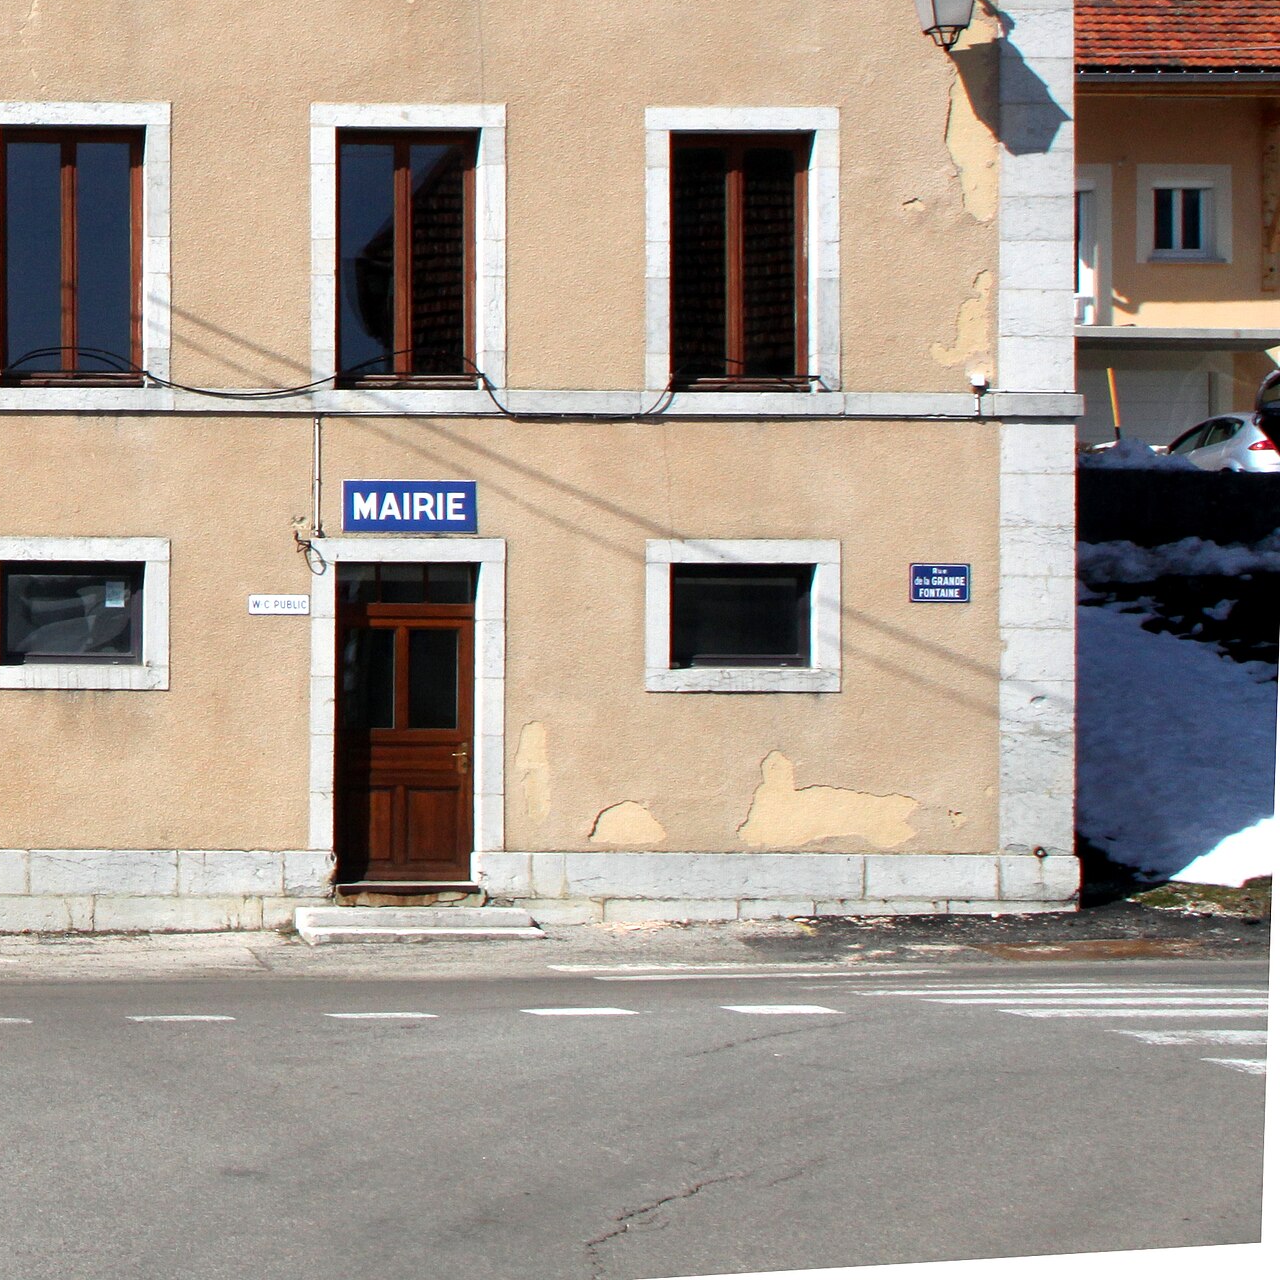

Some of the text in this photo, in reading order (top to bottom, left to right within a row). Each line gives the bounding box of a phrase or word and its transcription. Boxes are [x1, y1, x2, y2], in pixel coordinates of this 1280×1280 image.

[353, 492, 466, 520] MAIRIE
[931, 576, 966, 586] GRANDE
[918, 588, 960, 598] FONTAINE
[273, 600, 307, 609] PUBLIC
